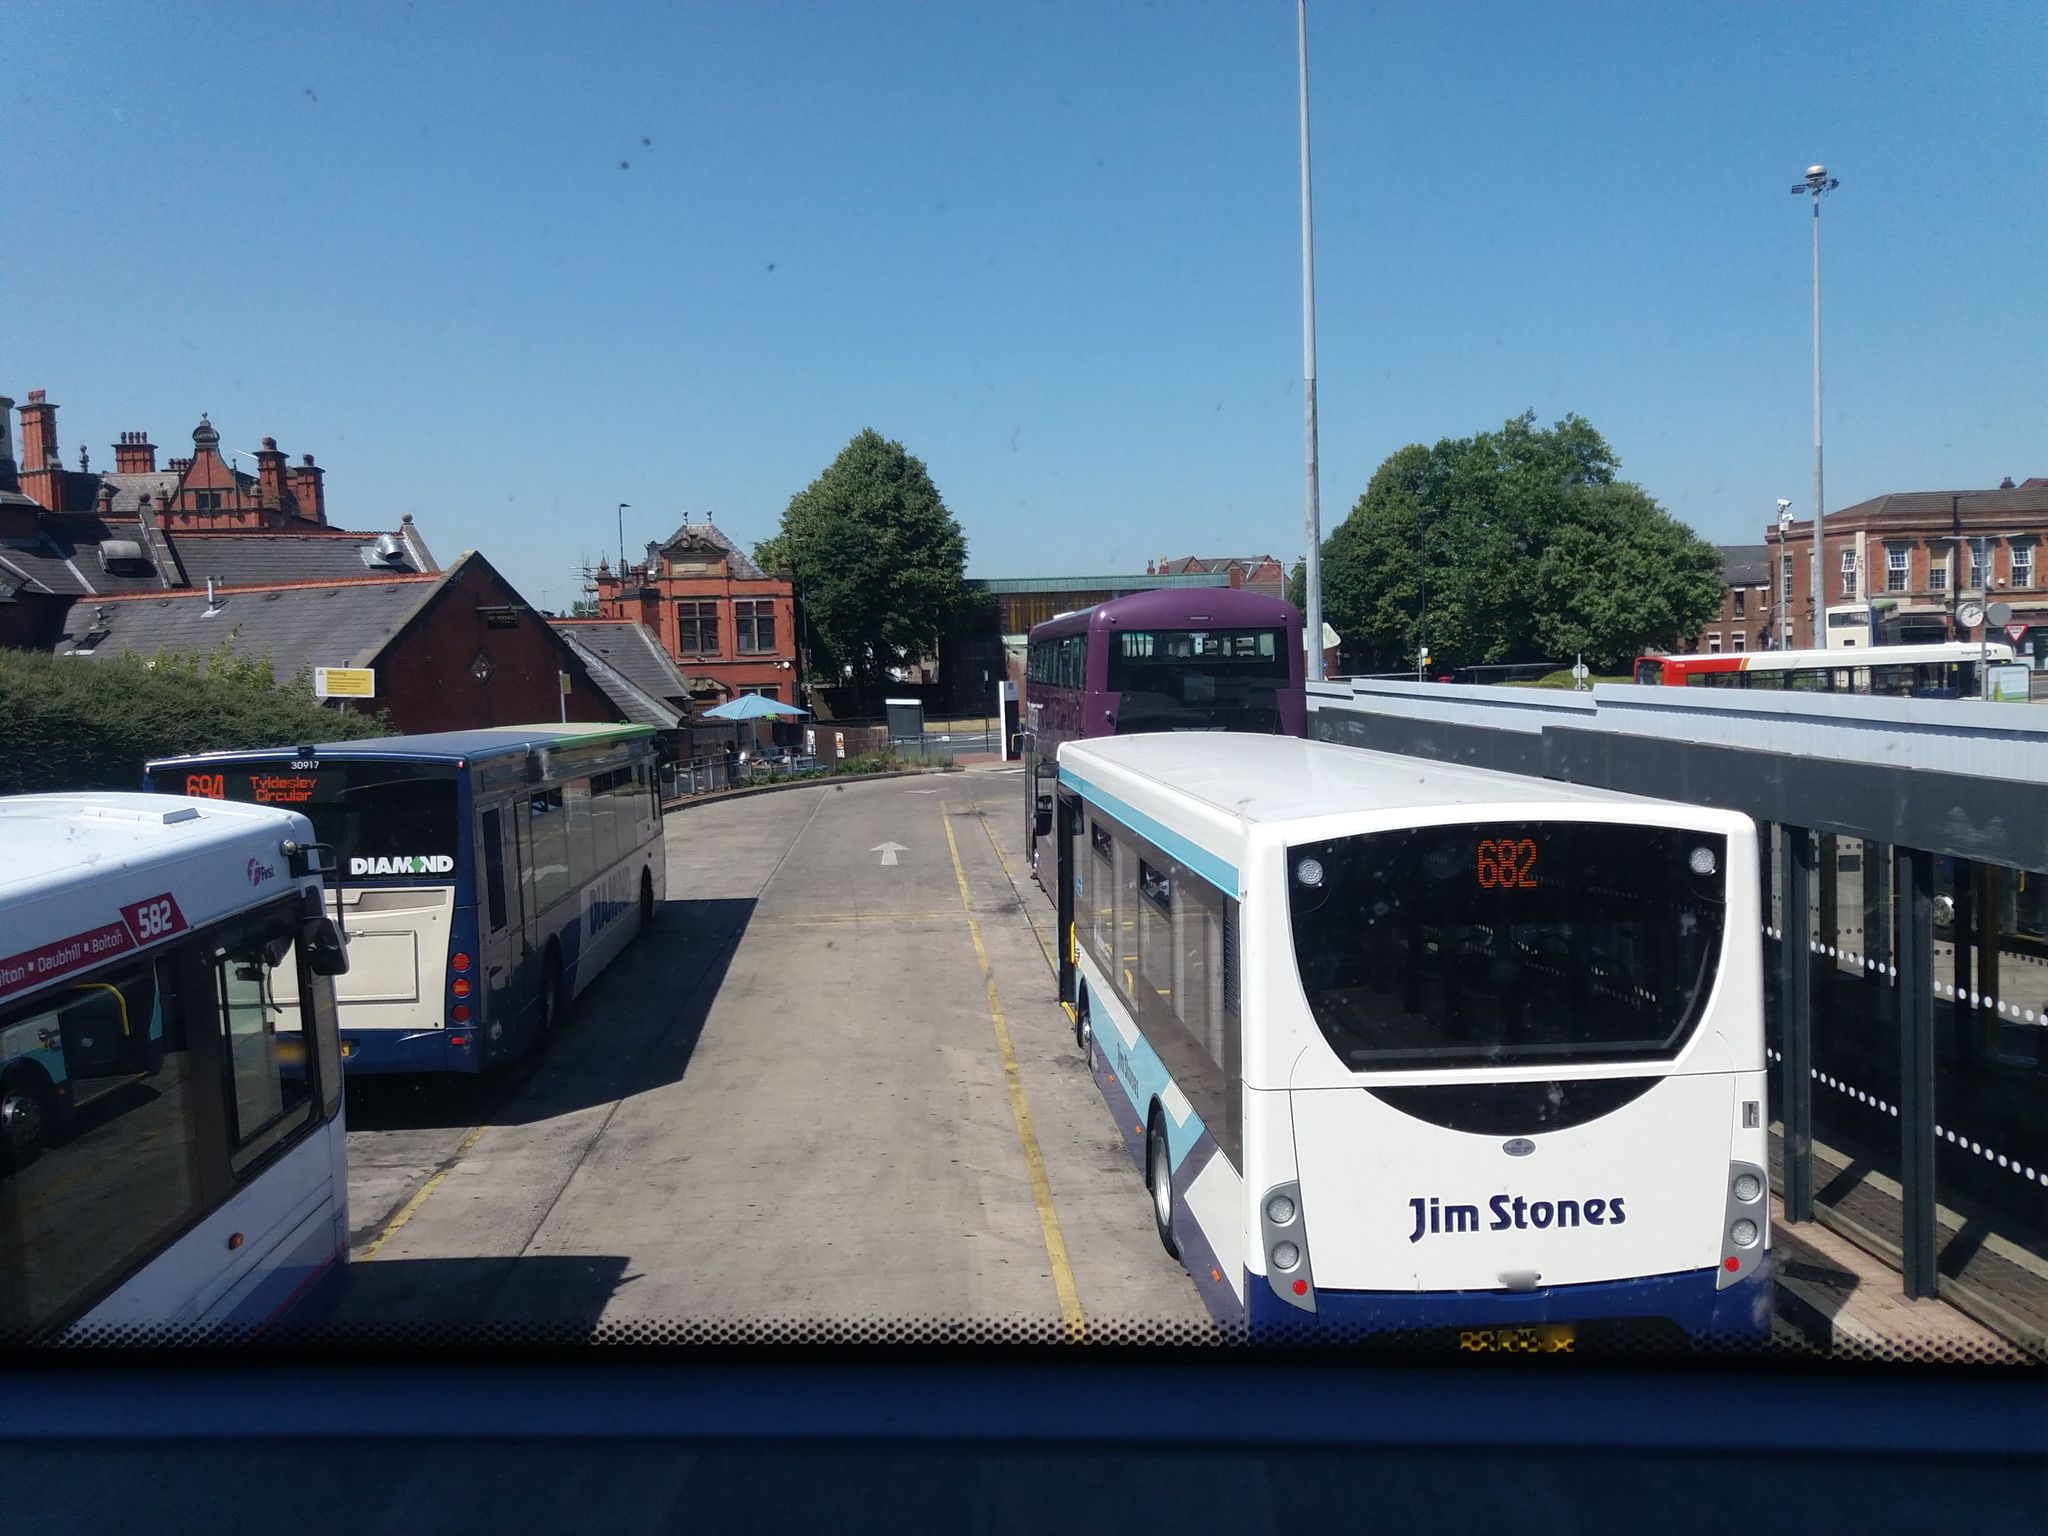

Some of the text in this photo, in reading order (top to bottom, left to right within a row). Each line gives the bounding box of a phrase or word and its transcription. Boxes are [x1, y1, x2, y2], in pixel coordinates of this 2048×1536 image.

[291, 761, 320, 770] 30917
[186, 774, 225, 800] 694
[249, 776, 317, 789] Tyldesley
[255, 788, 312, 801] Circular
[1477, 839, 1538, 888] 682
[138, 900, 173, 939] 582
[0, 932, 123, 987] lton Daubhill Bolton
[1408, 1194, 1627, 1244] Jim Stones
